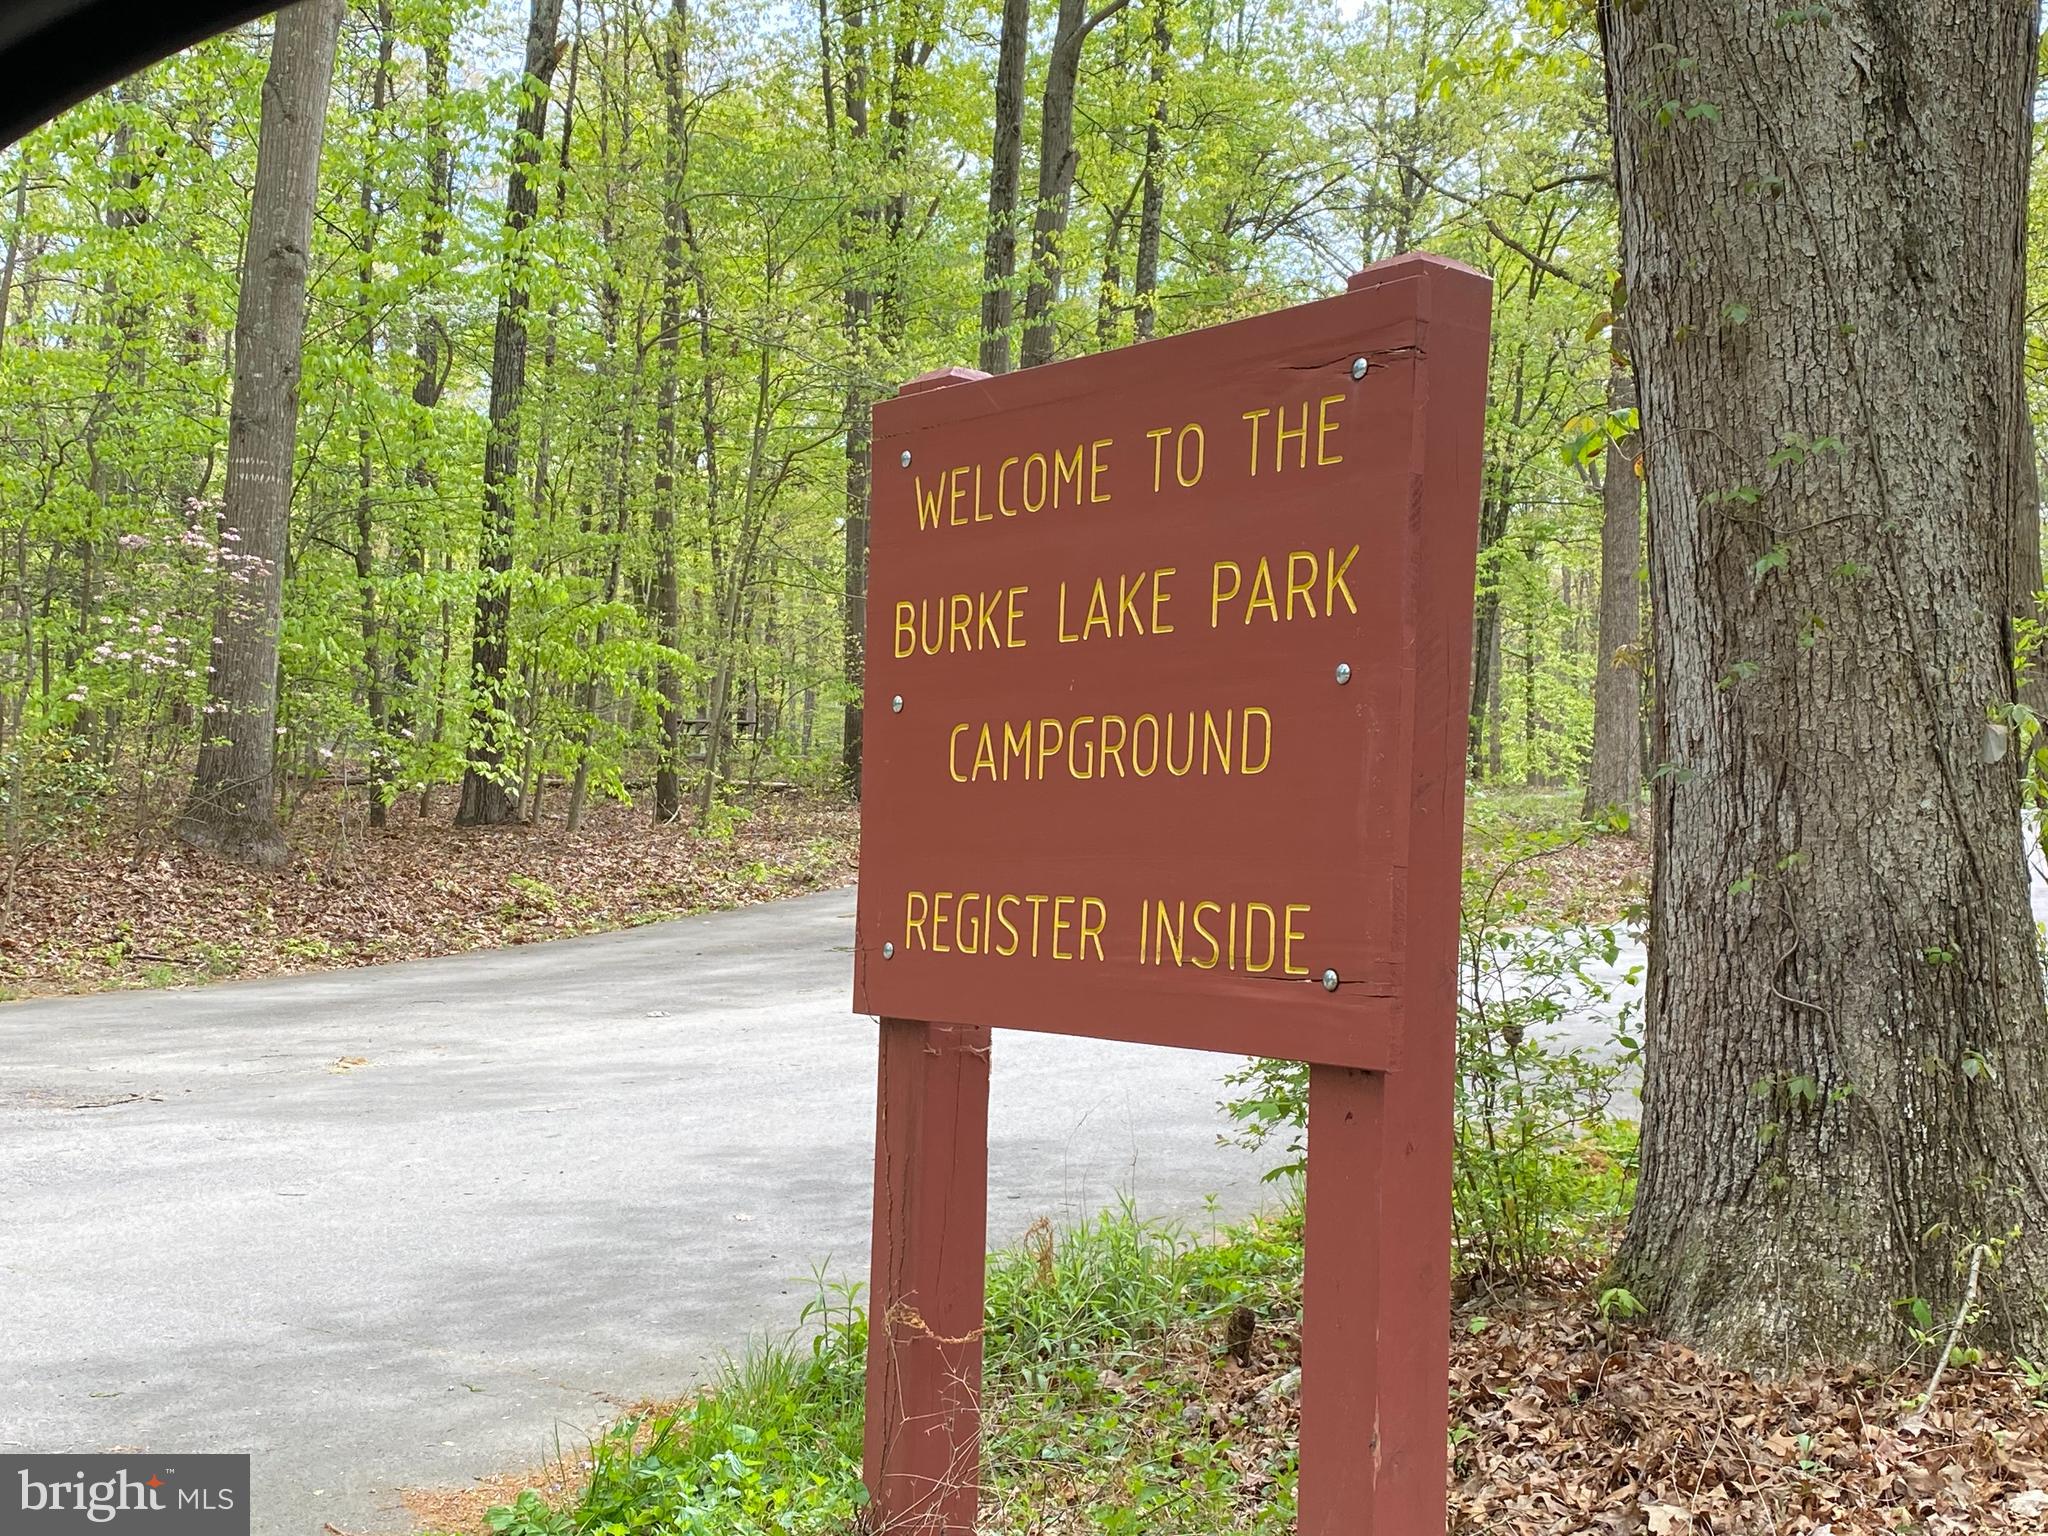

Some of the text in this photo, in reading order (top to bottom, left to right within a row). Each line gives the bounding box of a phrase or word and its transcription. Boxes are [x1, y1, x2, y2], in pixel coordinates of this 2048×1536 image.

[914, 393, 1346, 530] WELCOME TO THE
[892, 543, 1361, 660] BURKE LAKE PARK
[948, 706, 1272, 783] CAMPGROUND
[904, 890, 1312, 976] REGISTER INSIDE
